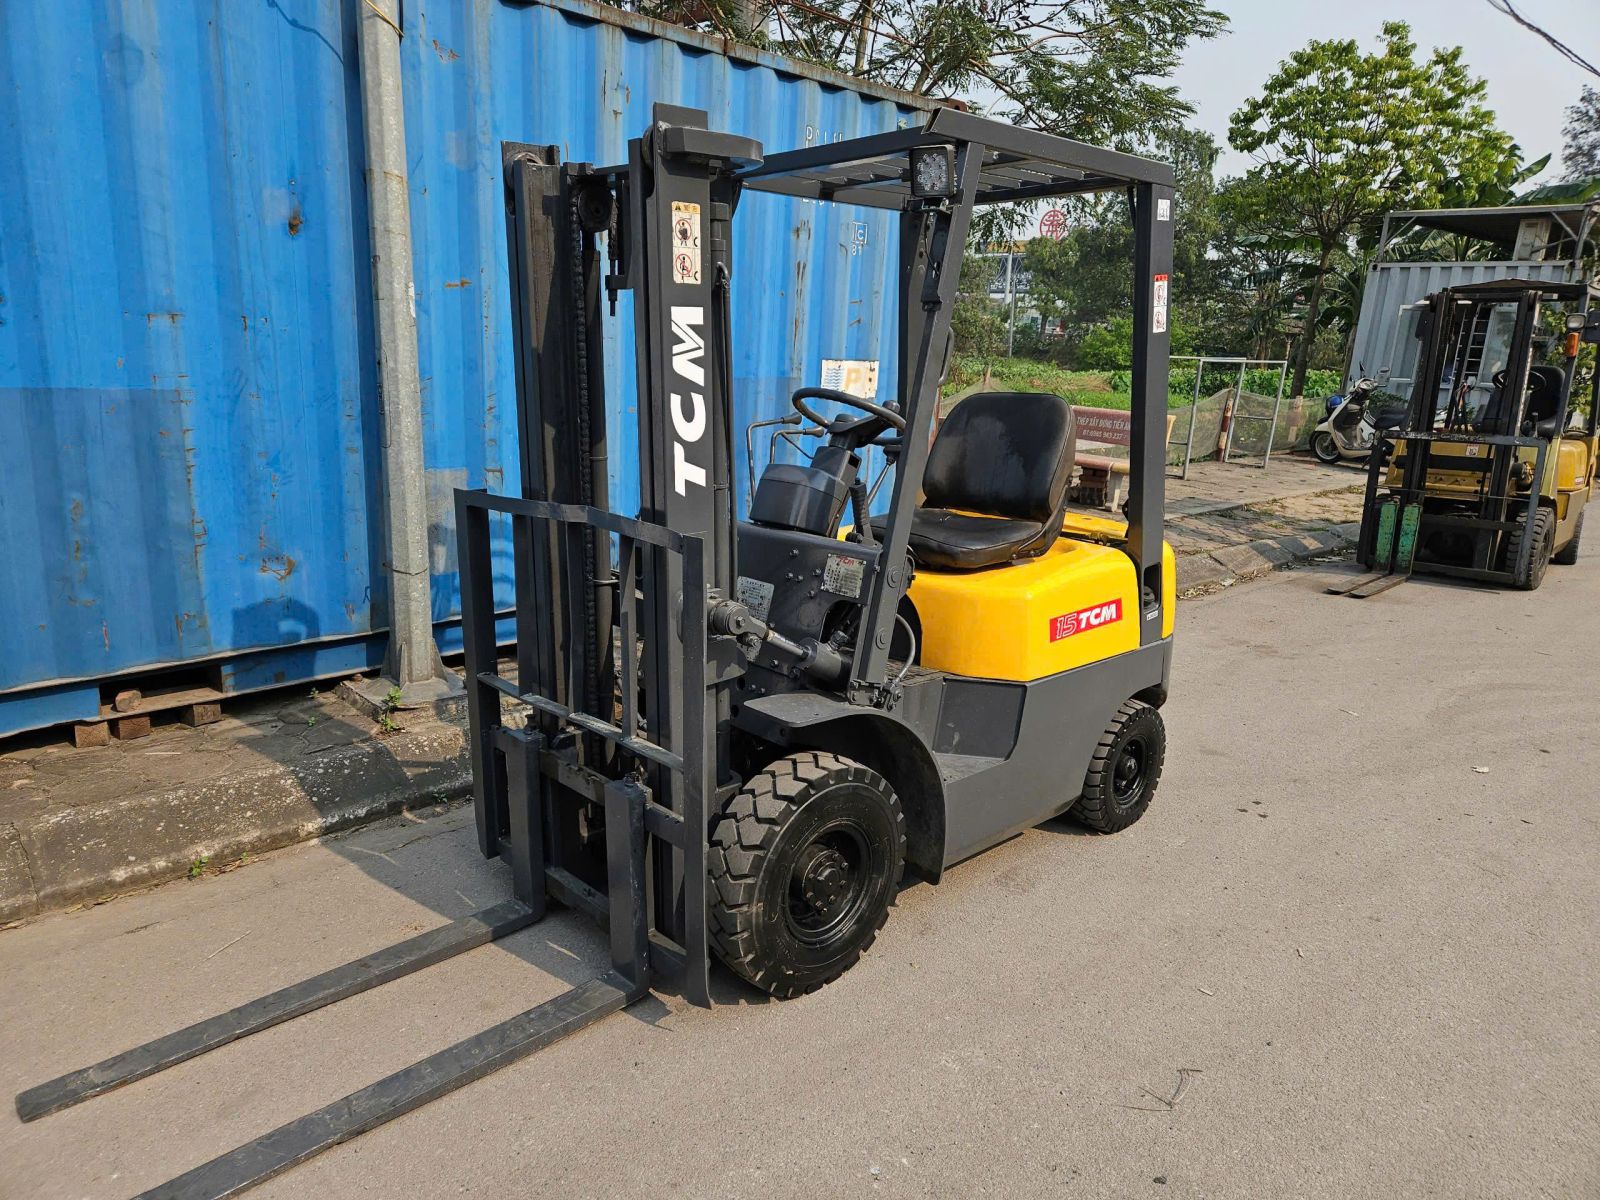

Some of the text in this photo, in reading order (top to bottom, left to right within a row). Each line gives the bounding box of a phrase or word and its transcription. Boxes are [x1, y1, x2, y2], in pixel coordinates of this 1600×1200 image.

[670, 306, 707, 497] TCM
[1056, 603, 1116, 639] 15 TCM
